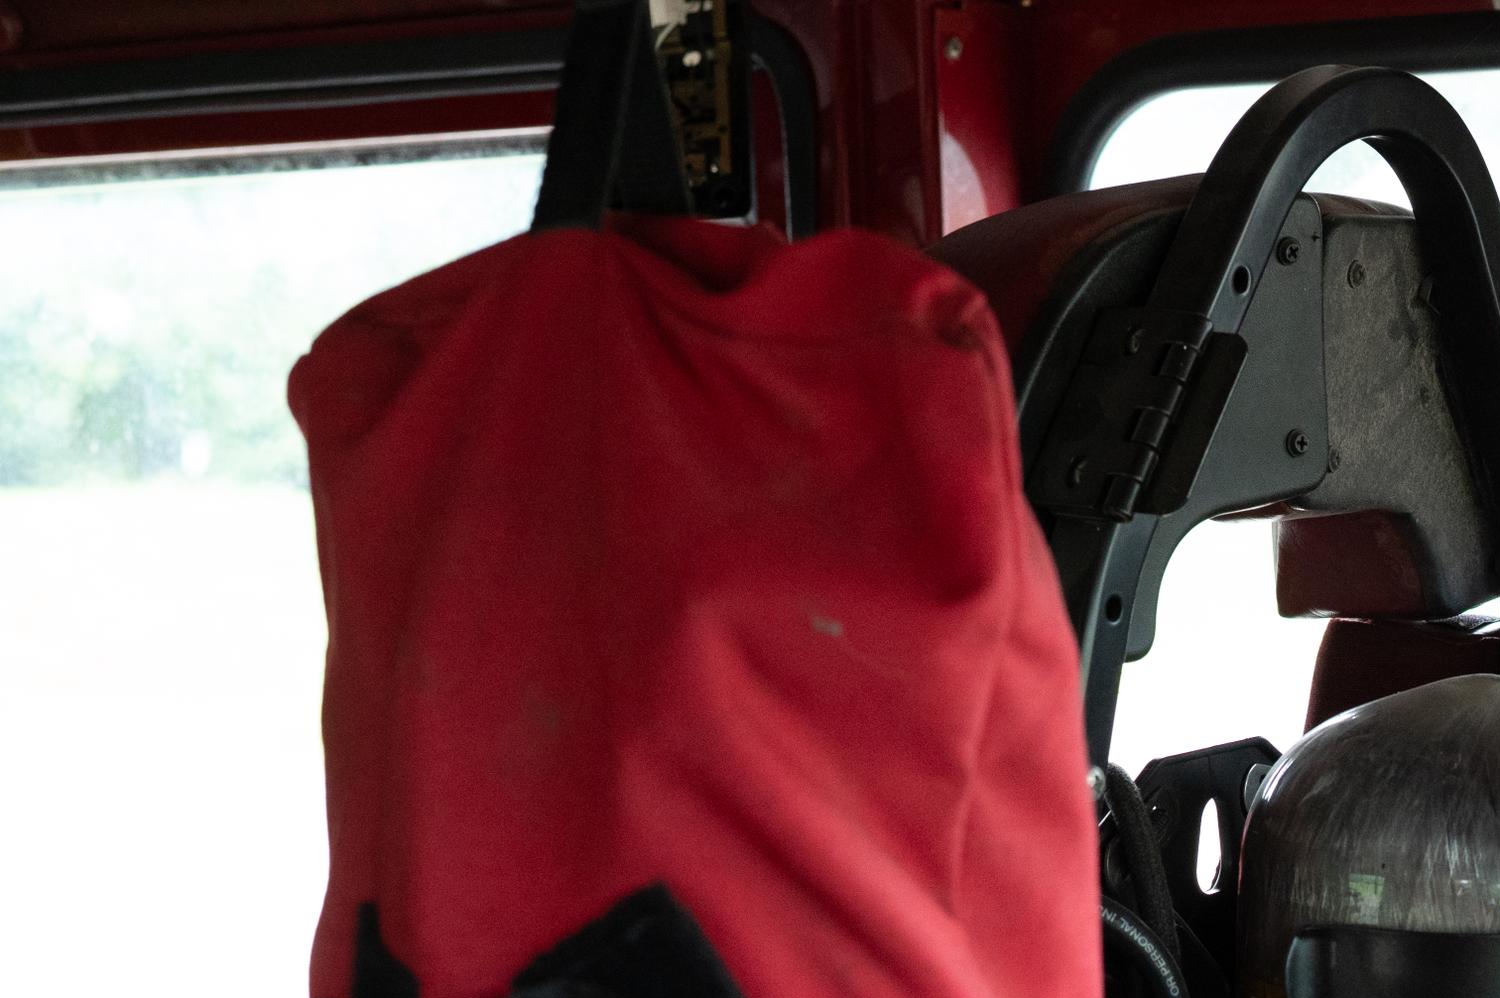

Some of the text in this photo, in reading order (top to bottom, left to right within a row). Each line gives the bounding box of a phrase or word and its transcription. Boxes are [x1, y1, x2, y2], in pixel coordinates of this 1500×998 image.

[1102, 908, 1117, 922] IN
[1119, 918, 1170, 976] PERSONAL
[1166, 976, 1180, 996] OR
